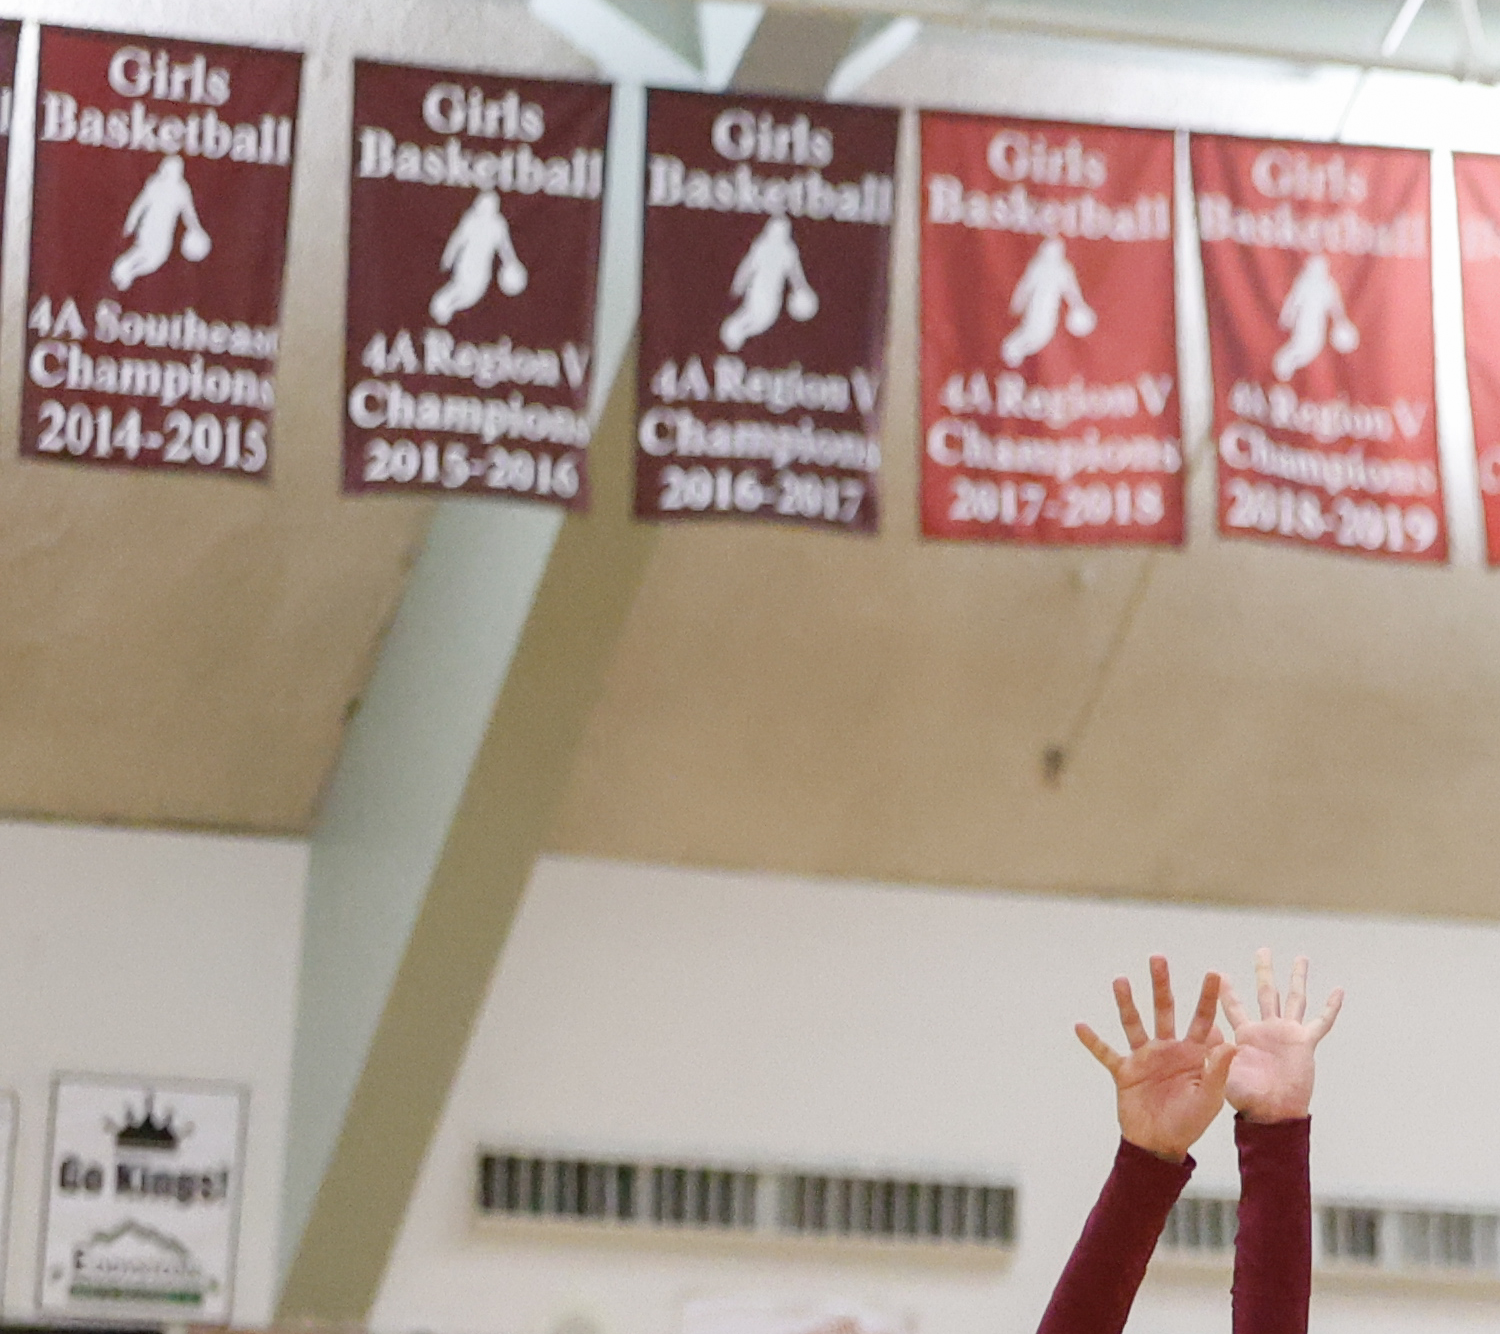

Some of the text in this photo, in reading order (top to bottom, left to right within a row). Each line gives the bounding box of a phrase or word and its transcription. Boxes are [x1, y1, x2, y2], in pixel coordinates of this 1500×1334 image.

[107, 44, 231, 107] Girls
[41, 89, 293, 167] Basketball
[422, 82, 545, 142] Girls
[710, 107, 834, 167] Girls
[358, 125, 604, 200] Basketball
[648, 153, 894, 226] Basketball
[986, 128, 1108, 190] Girls
[1252, 147, 1368, 205] Girls
[928, 173, 1170, 242] Basketball
[28, 294, 87, 341] 4A
[29, 338, 277, 411] Champions
[361, 327, 590, 390] 4A Region V
[651, 354, 711, 403] 4A
[713, 354, 851, 414] Region
[348, 378, 592, 450] Champions
[995, 371, 1139, 430] Region
[1136, 373, 1174, 416] V
[1268, 383, 1395, 444] Region
[1393, 398, 1429, 439] V
[36, 399, 268, 473] 2014-2015
[638, 406, 882, 473] Champions
[927, 418, 1182, 482] Champions
[363, 437, 580, 500] 2015-2016
[659, 464, 865, 523] 2016-2017
[949, 475, 1165, 528] 2017-2018
